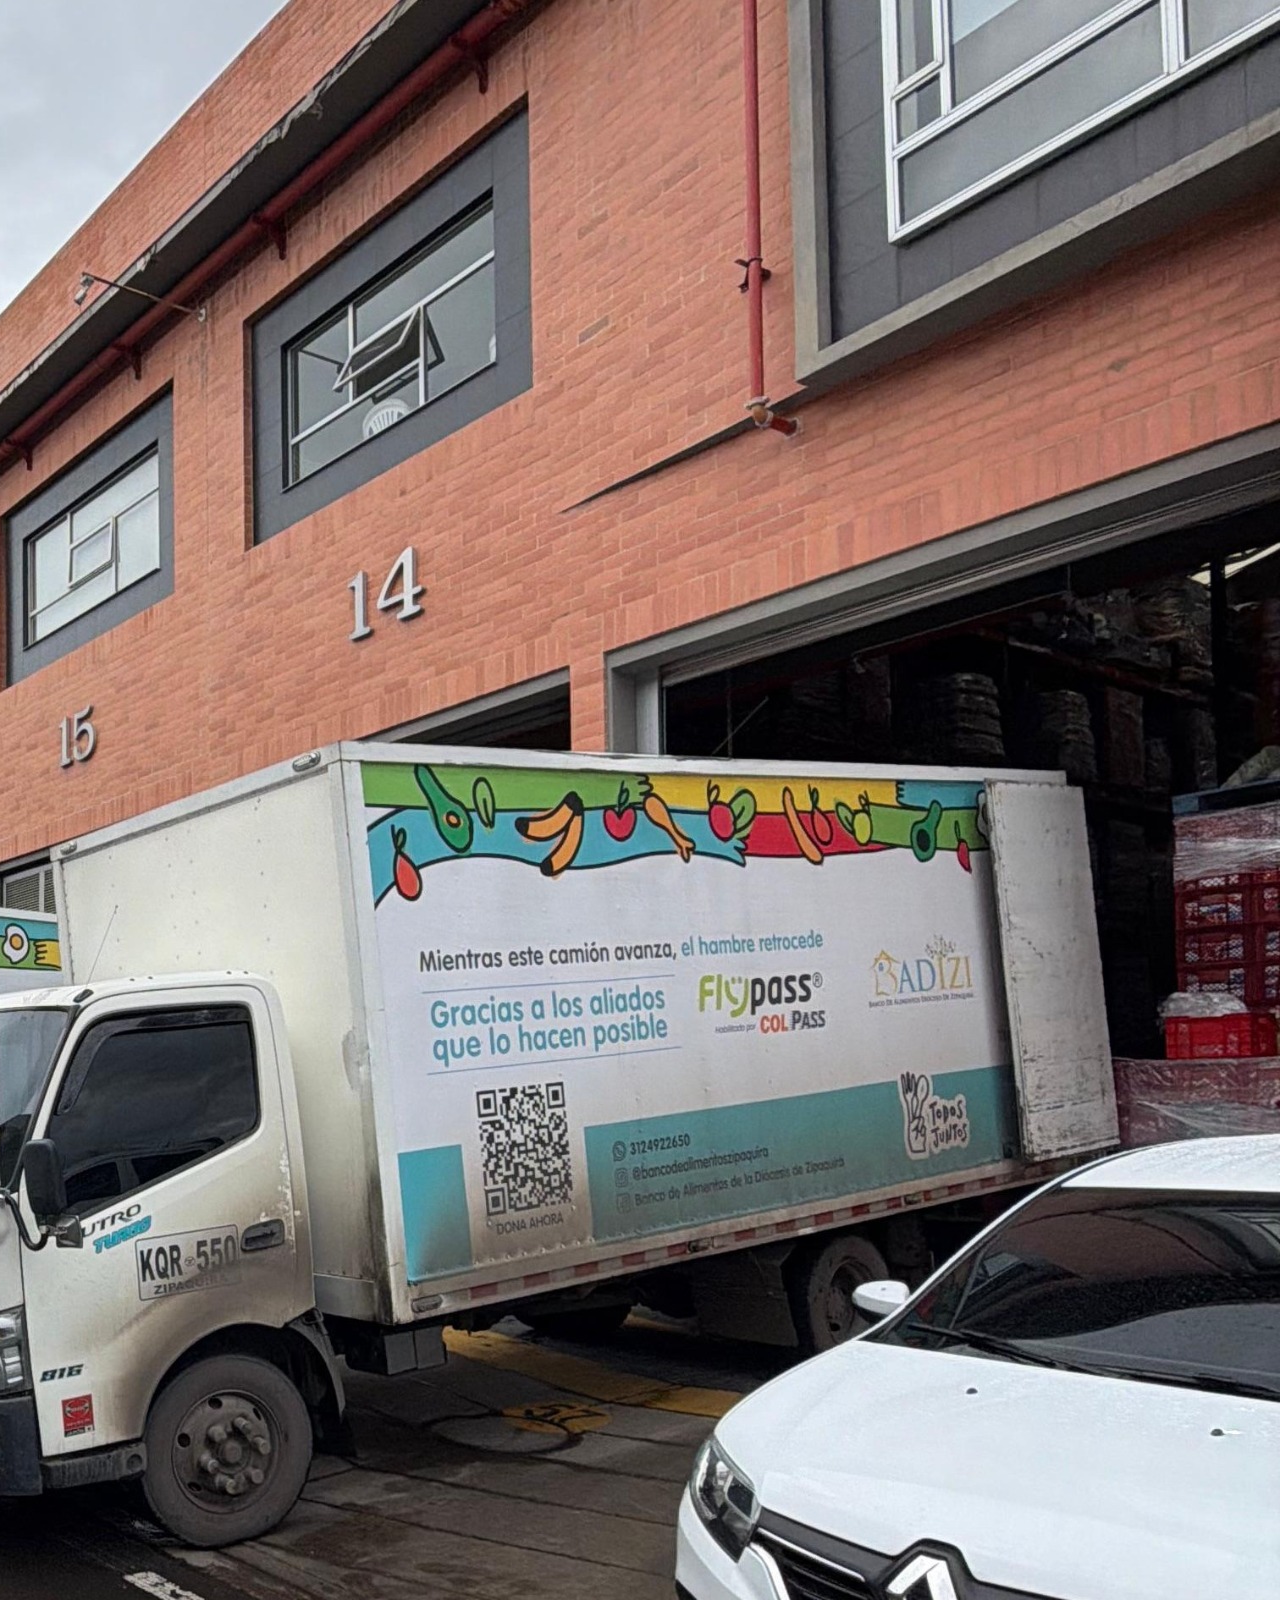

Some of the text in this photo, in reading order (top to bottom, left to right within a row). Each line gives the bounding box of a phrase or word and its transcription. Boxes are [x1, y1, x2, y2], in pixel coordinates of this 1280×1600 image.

[348, 545, 426, 642] 14
[58, 704, 96, 768] 15
[420, 929, 824, 973] Mientras este camión avanza, el hambre retrocede
[430, 985, 665, 1029] Gracias a los aliados
[760, 1015, 788, 1034] COL
[791, 1009, 826, 1031] PASS
[432, 1015, 668, 1068] que lo hacen posible
[929, 1100, 964, 1126] TODOS
[630, 1133, 691, 1156] 3124922650
[931, 1123, 968, 1147] JUNTOS
[82, 1203, 142, 1238] UTRO
[495, 1212, 564, 1236] DONA AHORA
[140, 1234, 238, 1283] KQR 550
[39, 1363, 84, 1383] 816
